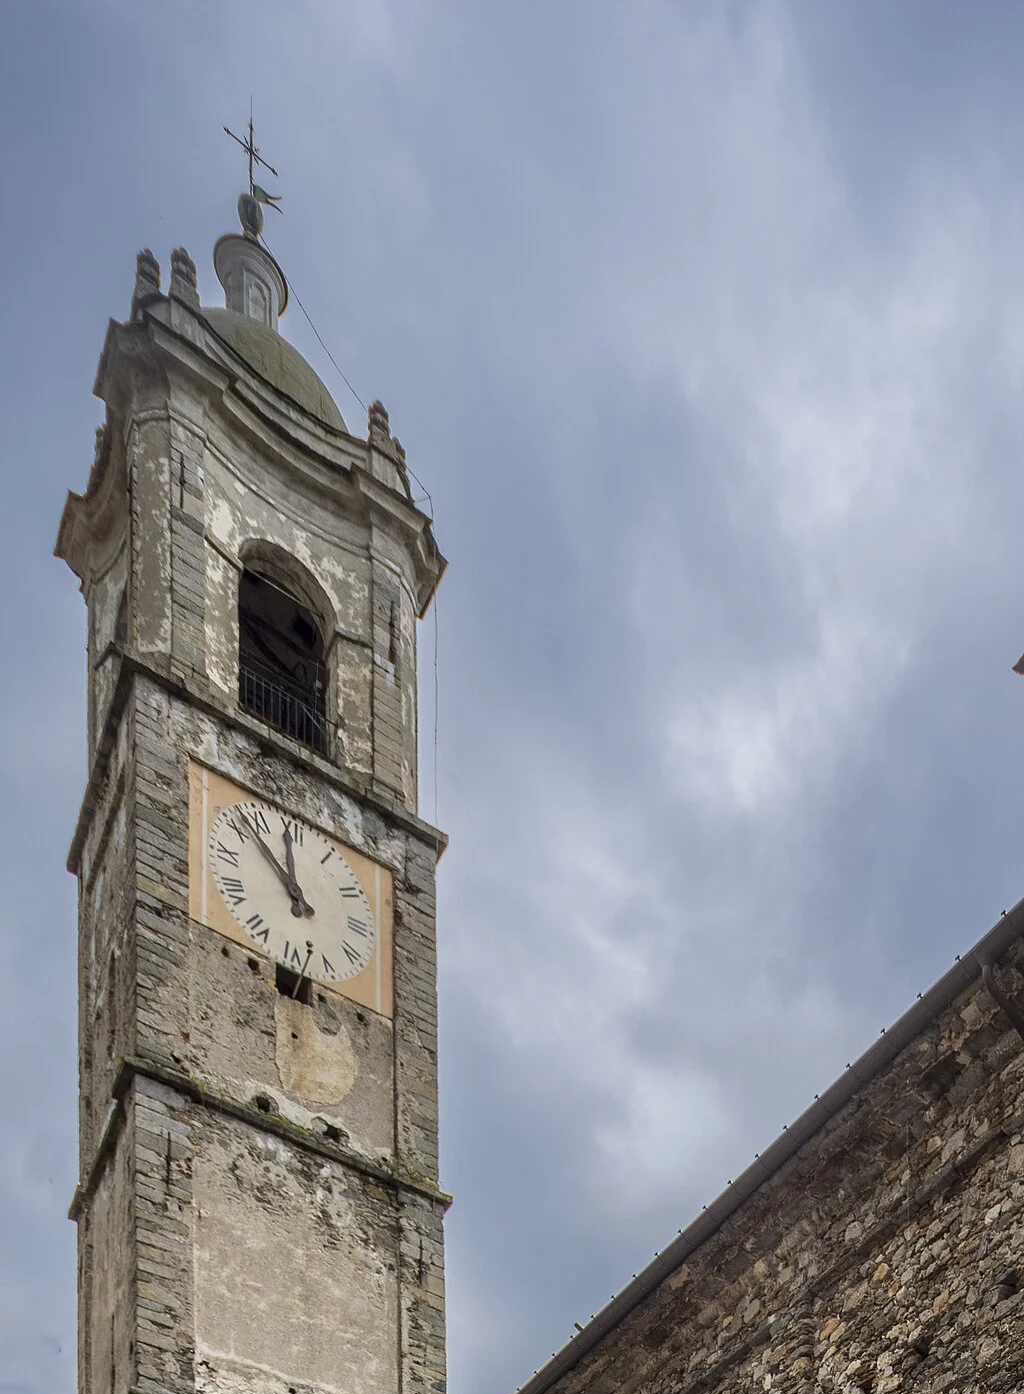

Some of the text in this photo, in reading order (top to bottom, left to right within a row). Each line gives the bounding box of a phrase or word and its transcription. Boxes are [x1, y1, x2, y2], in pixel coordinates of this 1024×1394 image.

[226, 818, 249, 843] X
[247, 811, 271, 834] XI
[217, 841, 239, 867] IX
[221, 877, 246, 906] VIII
[339, 887, 359, 898] II
[246, 914, 269, 943] VII
[347, 916, 367, 938] III
[283, 941, 302, 967] VI
[320, 953, 336, 973] V
[341, 940, 361, 965] IV
